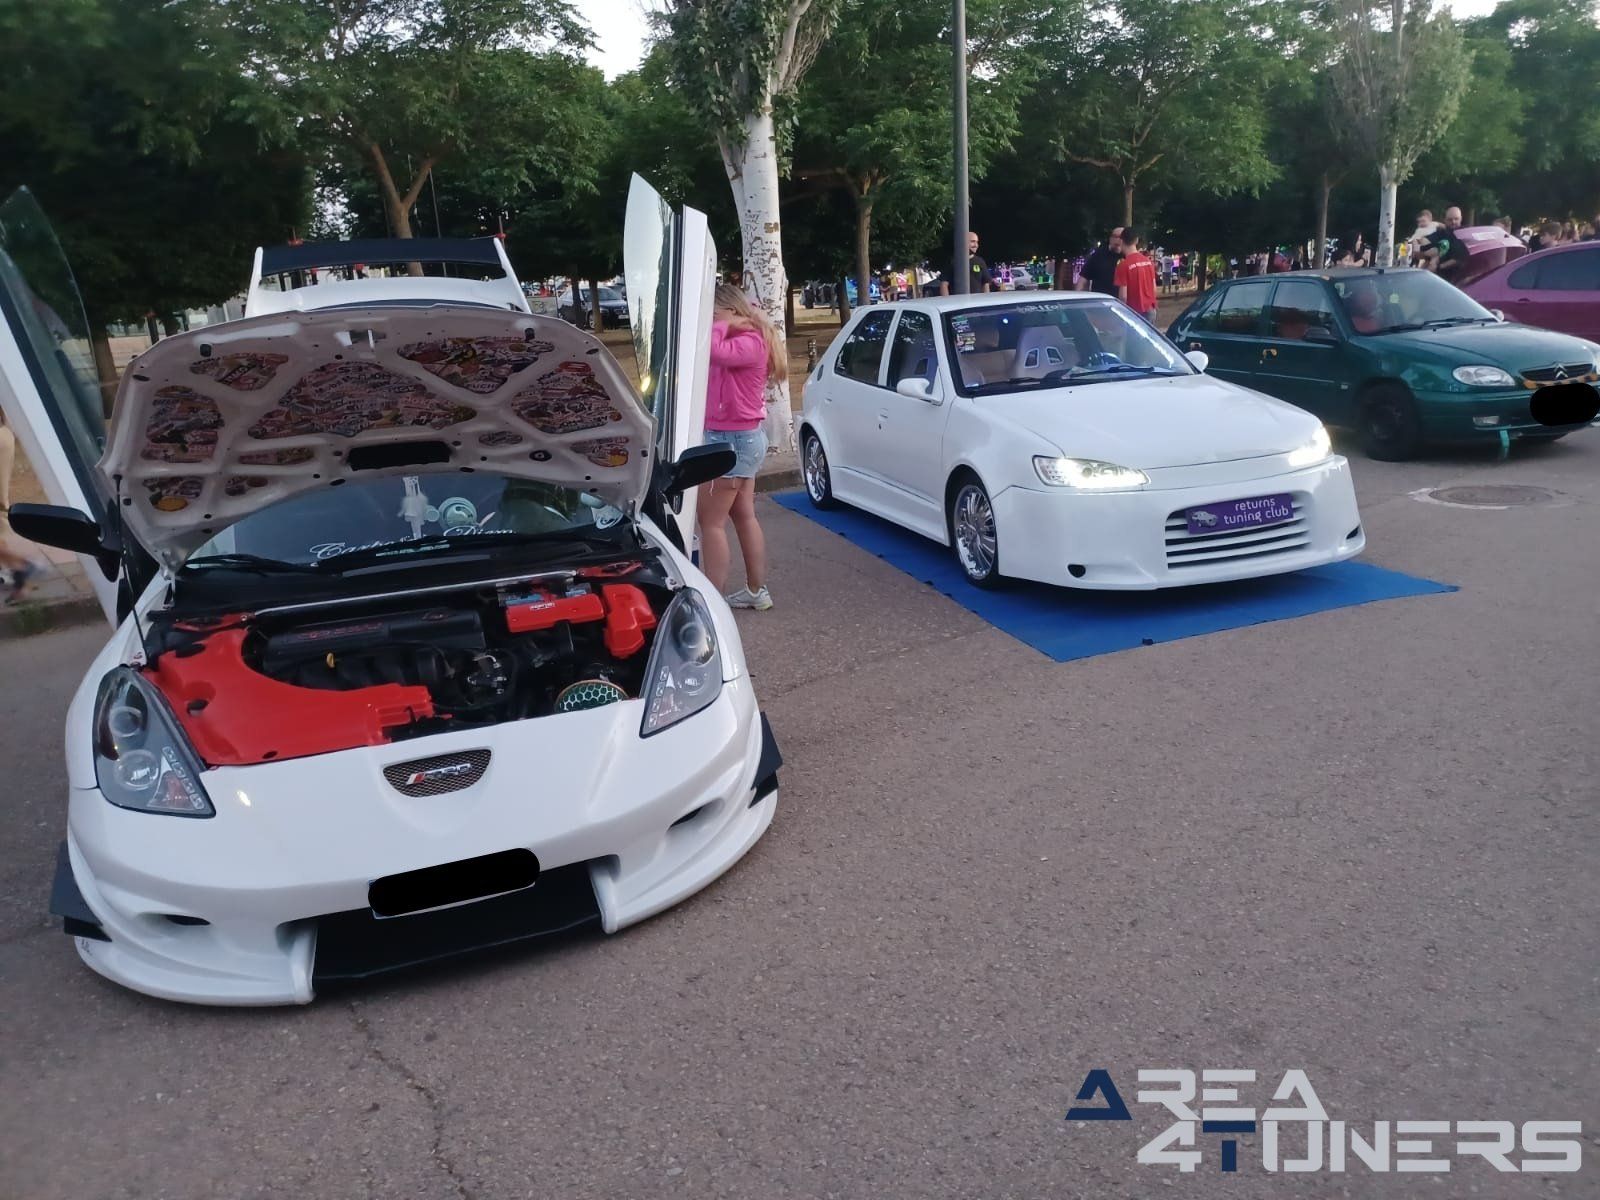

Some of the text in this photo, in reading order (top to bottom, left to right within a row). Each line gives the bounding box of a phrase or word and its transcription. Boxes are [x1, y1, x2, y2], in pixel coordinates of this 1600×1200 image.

[1235, 498, 1276, 511] returns
[1224, 505, 1289, 523] tuning club
